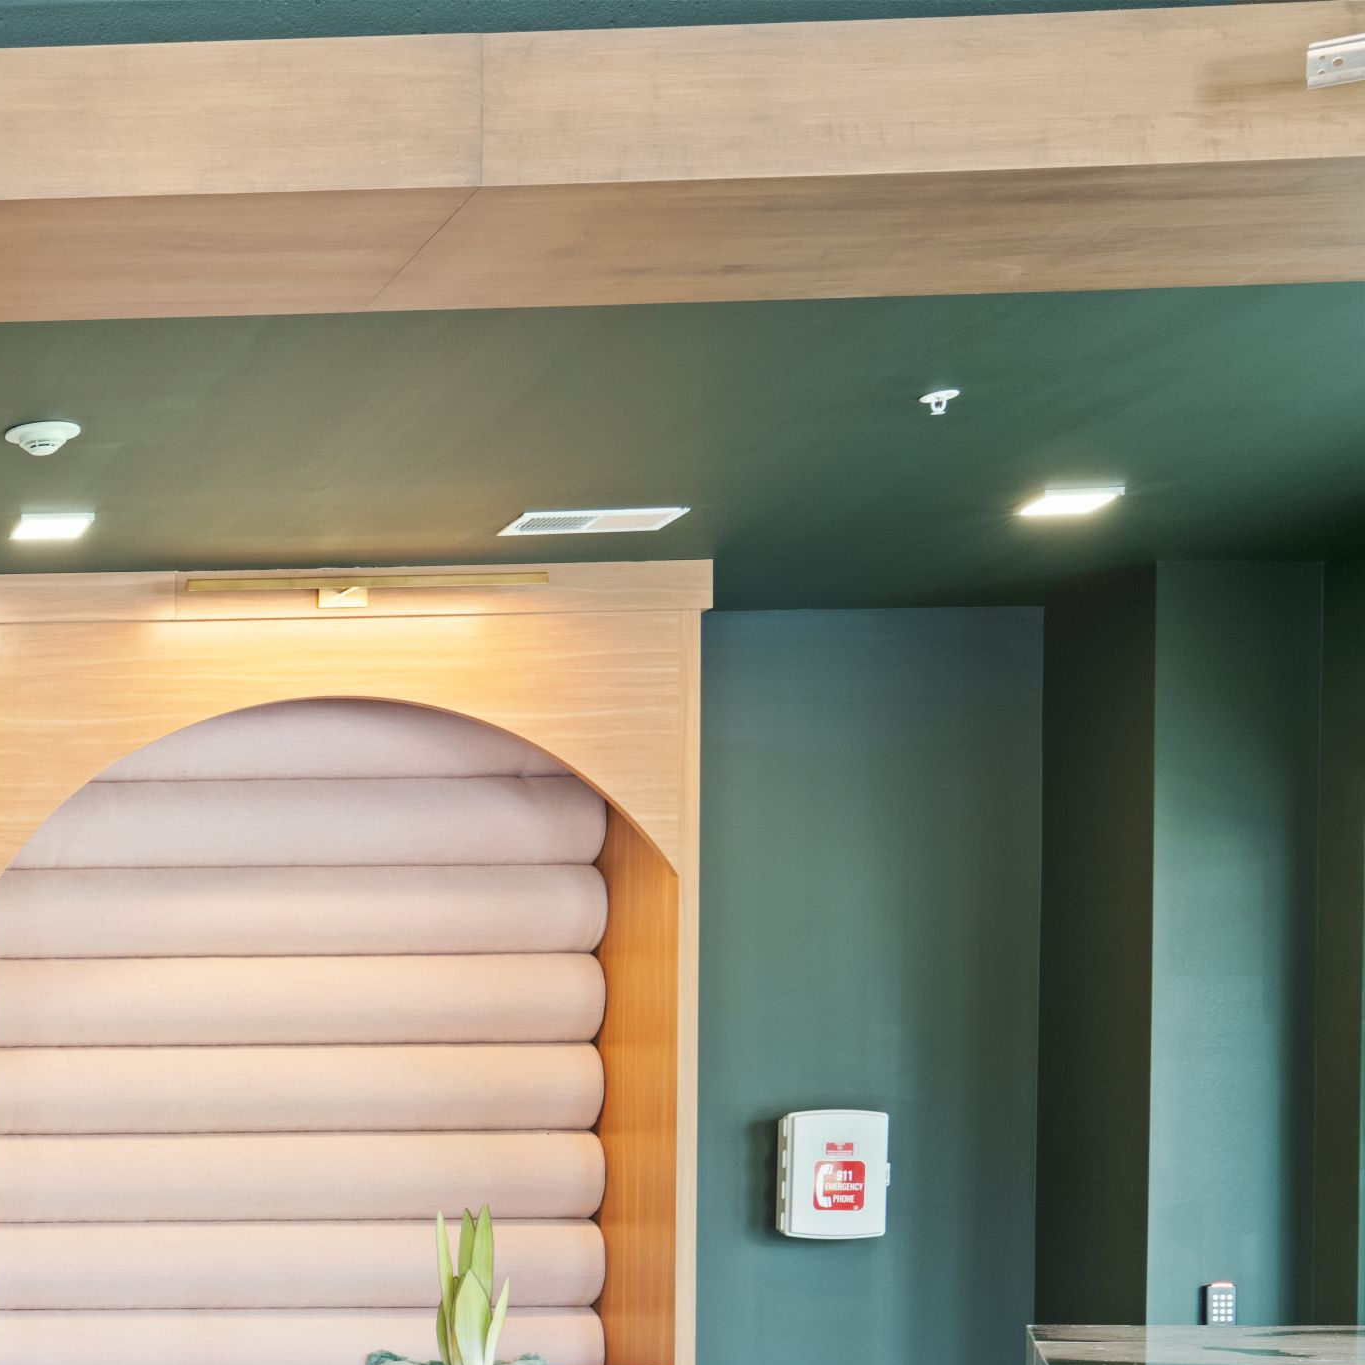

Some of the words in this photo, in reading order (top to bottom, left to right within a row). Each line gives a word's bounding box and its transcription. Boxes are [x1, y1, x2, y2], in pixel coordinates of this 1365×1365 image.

[836, 1170, 853, 1181] 911
[825, 1182, 864, 1191] EMERGENCY
[832, 1194, 855, 1204] PHONE
